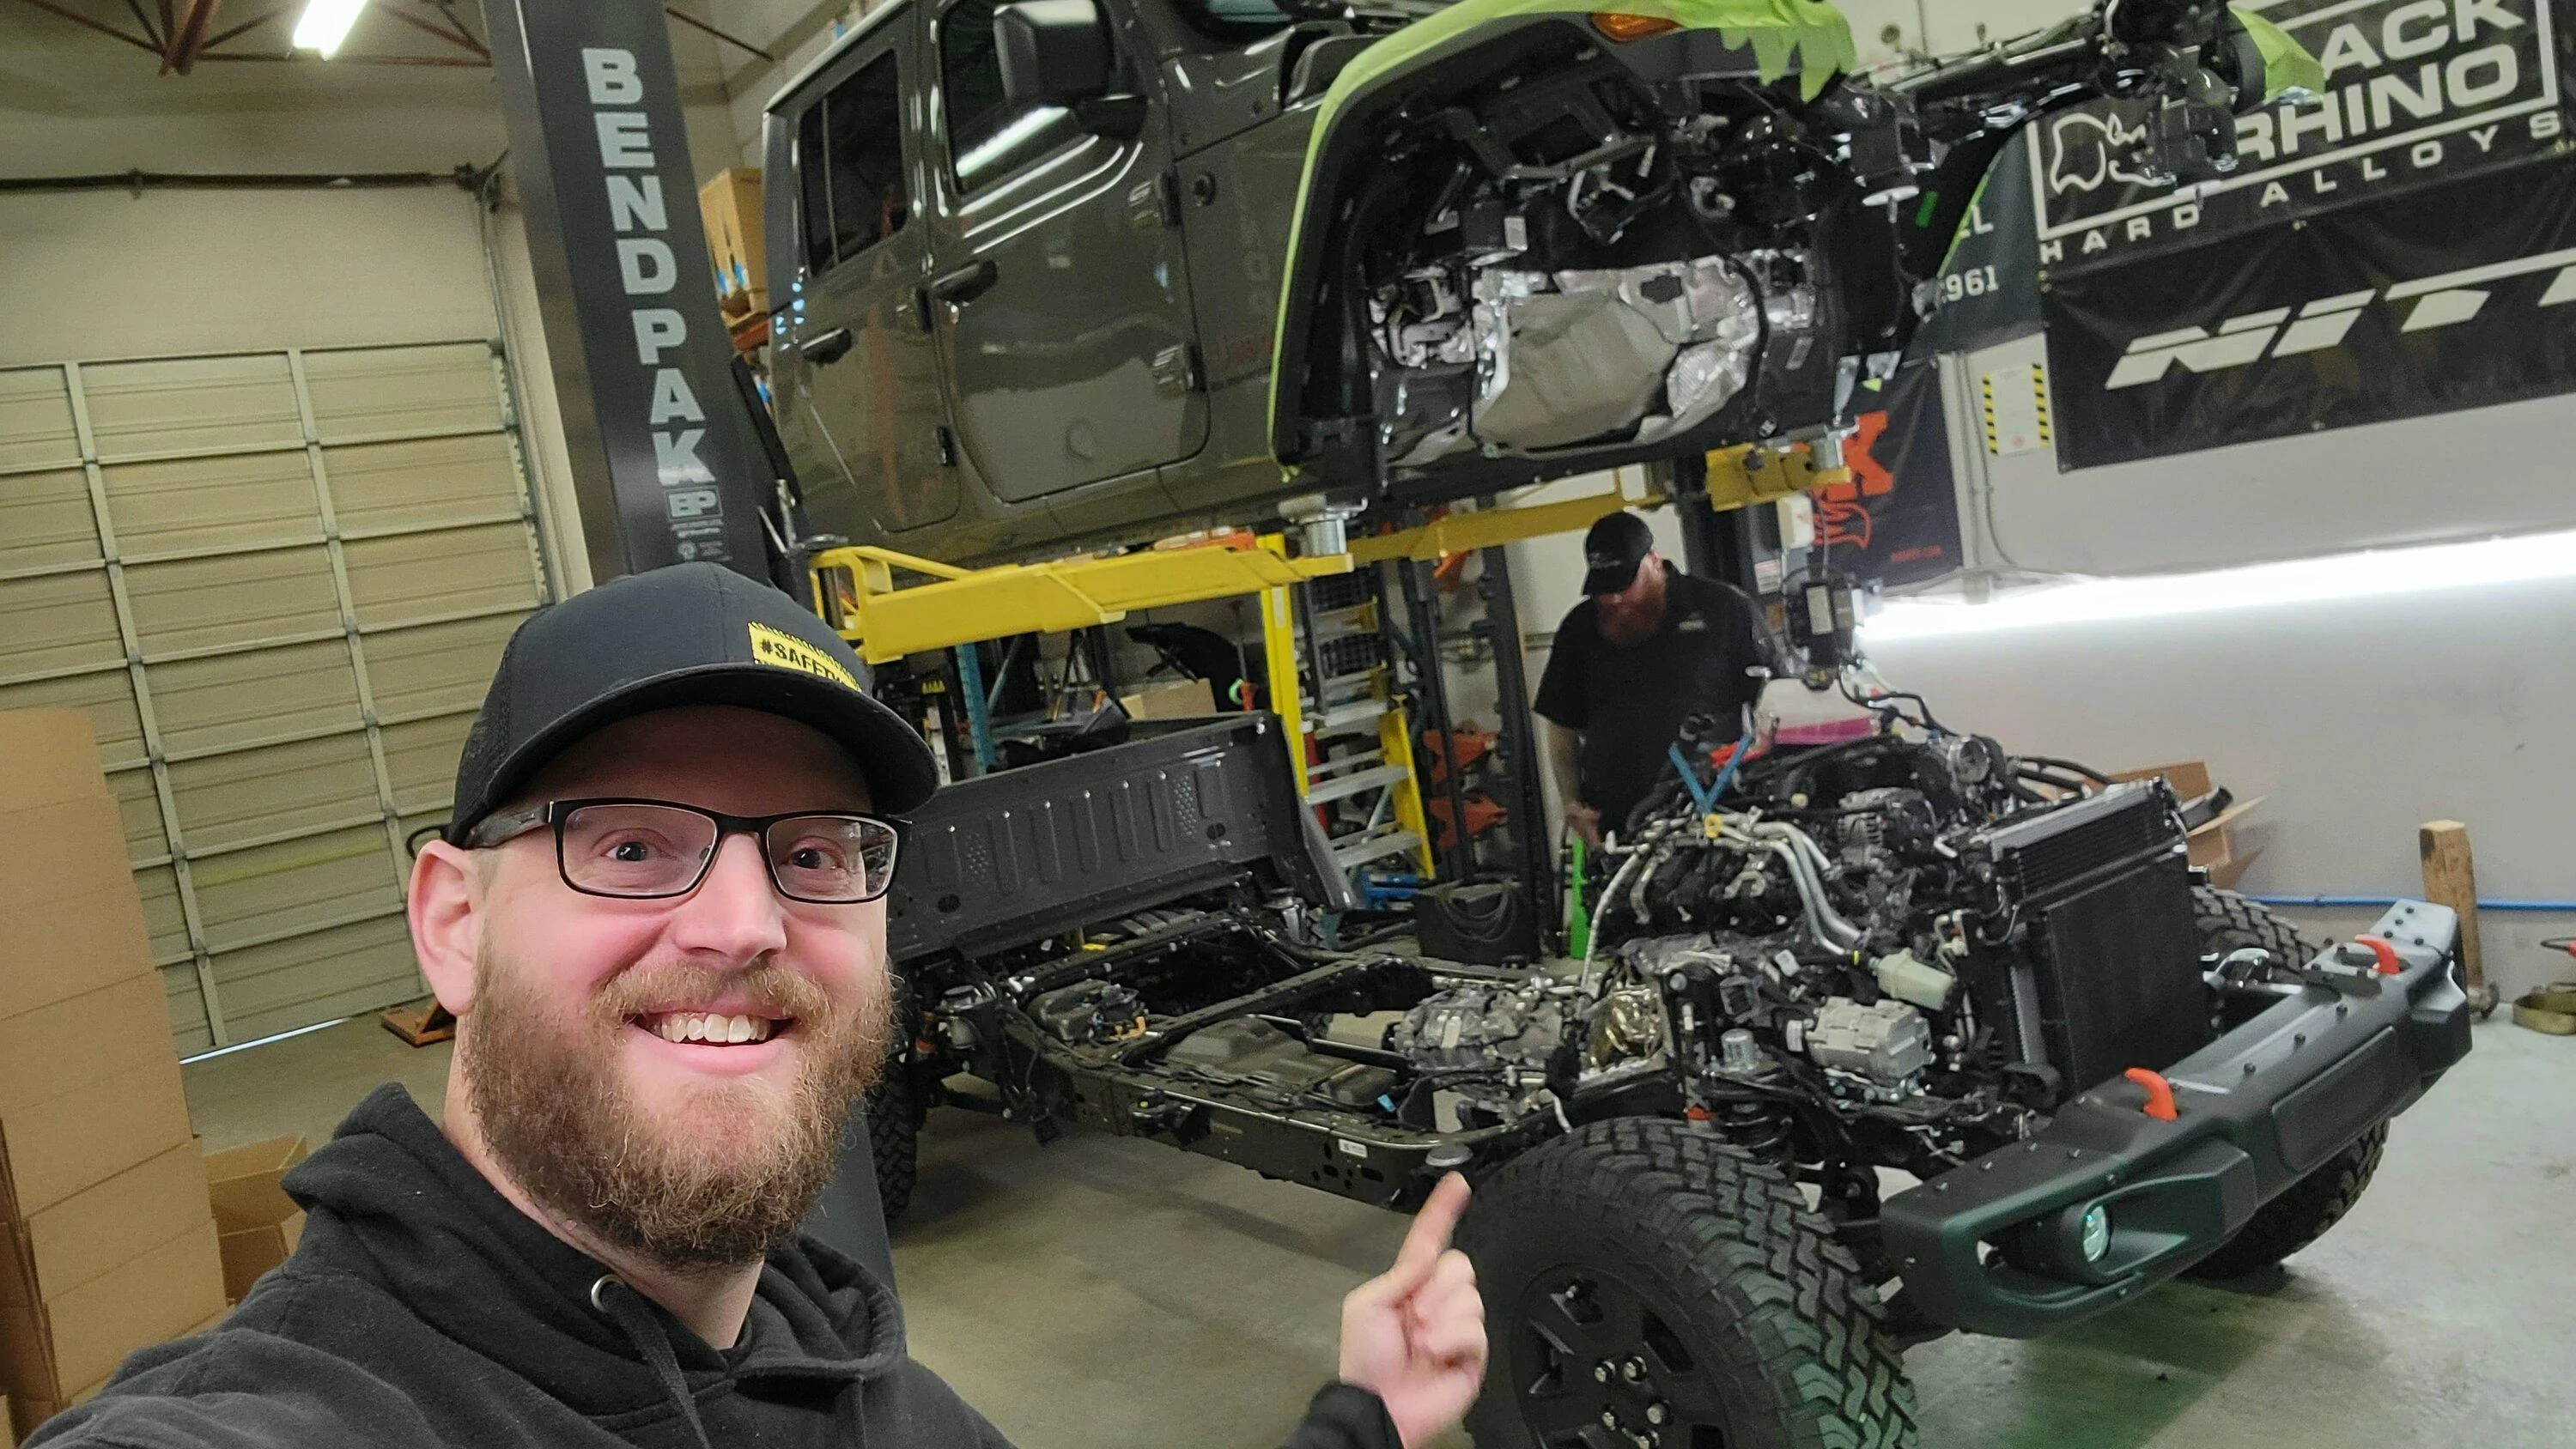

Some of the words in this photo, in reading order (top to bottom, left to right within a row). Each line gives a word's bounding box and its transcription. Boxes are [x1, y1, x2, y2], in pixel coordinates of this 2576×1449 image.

[581, 47, 716, 487] BENDPAK
[2039, 203, 2201, 264] HARD
[2260, 110, 2561, 207] ALLOYS
